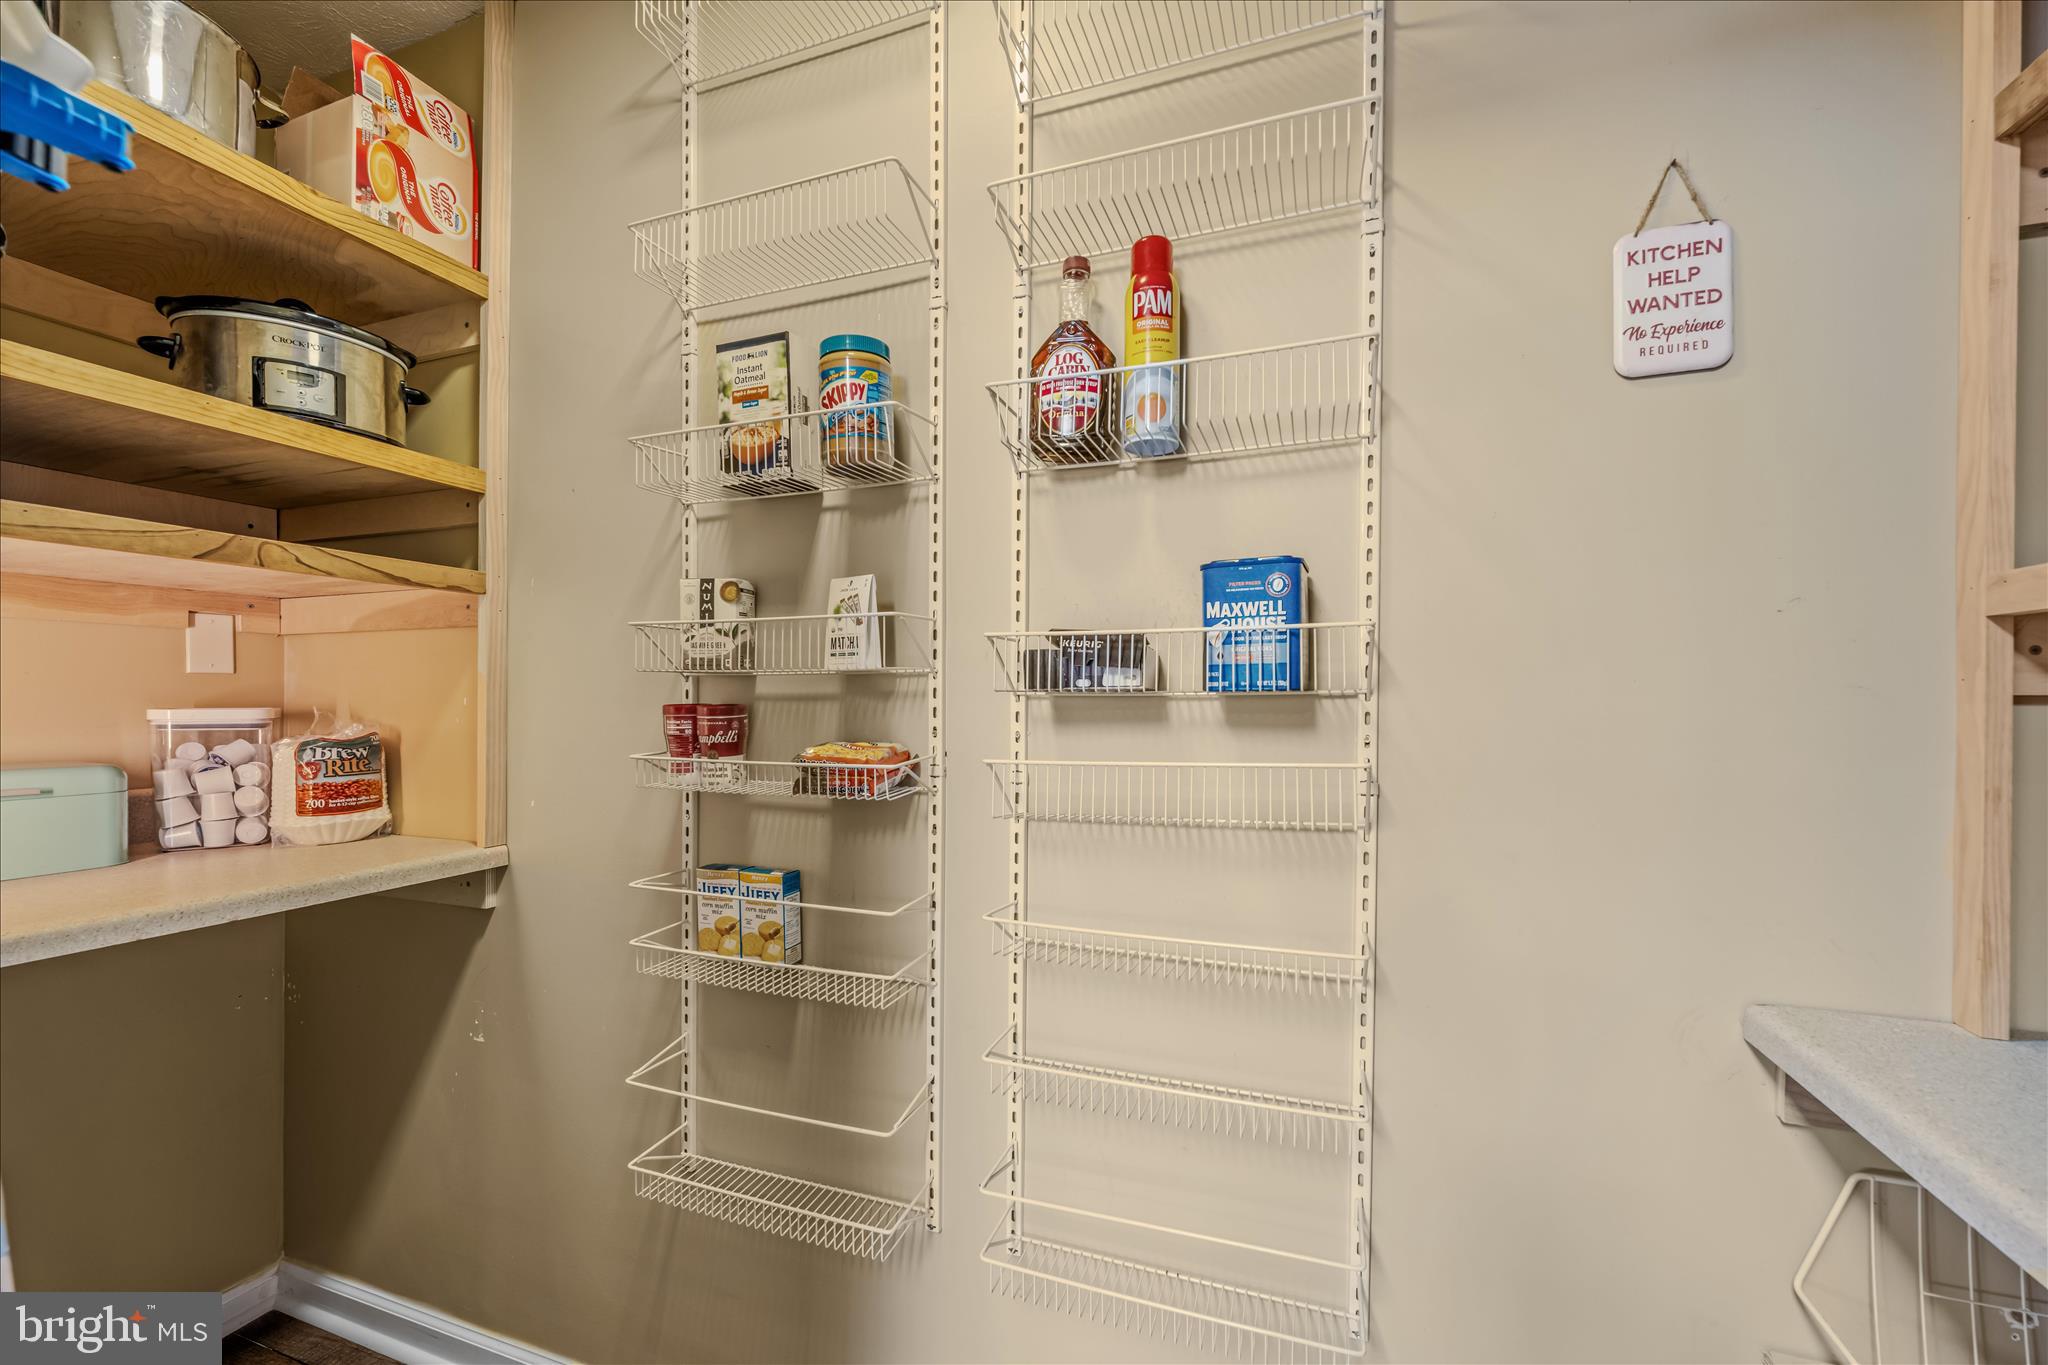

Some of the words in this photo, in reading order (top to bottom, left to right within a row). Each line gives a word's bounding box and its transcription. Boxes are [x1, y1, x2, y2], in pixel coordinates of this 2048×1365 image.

[424, 99, 443, 138] mate
[433, 99, 453, 145] Coffee
[399, 165, 413, 205] ORIGINAL
[428, 183, 443, 221] mate
[437, 181, 457, 228] Coffee
[1627, 238, 1723, 266] KITCHEN
[1648, 266, 1701, 287] HELP
[1133, 289, 1172, 318] PAM
[1627, 288, 1723, 315] WANTED
[1136, 319, 1169, 328] ORIGINAL
[1622, 325, 1648, 342] No
[1650, 318, 1726, 342] Experience
[731, 353, 746, 363] FOOD
[754, 349, 768, 359] LION
[1640, 339, 1709, 357] REQUIRED
[736, 362, 763, 375] Instant
[1055, 352, 1084, 366] LOG
[733, 371, 766, 386] Oatmeal
[821, 382, 866, 410] SKIPPY
[700, 581, 714, 624] NUMI
[1206, 599, 1287, 619] MAXWELL
[1231, 616, 1287, 633] HOUSE
[1062, 639, 1103, 649] KEURIG
[323, 757, 371, 778] Rite
[304, 798, 326, 809] 700
[698, 881, 737, 896] JIFFY
[741, 885, 780, 900] JIFFY
[715, 902, 734, 910] muffin
[757, 907, 778, 915] muffin
